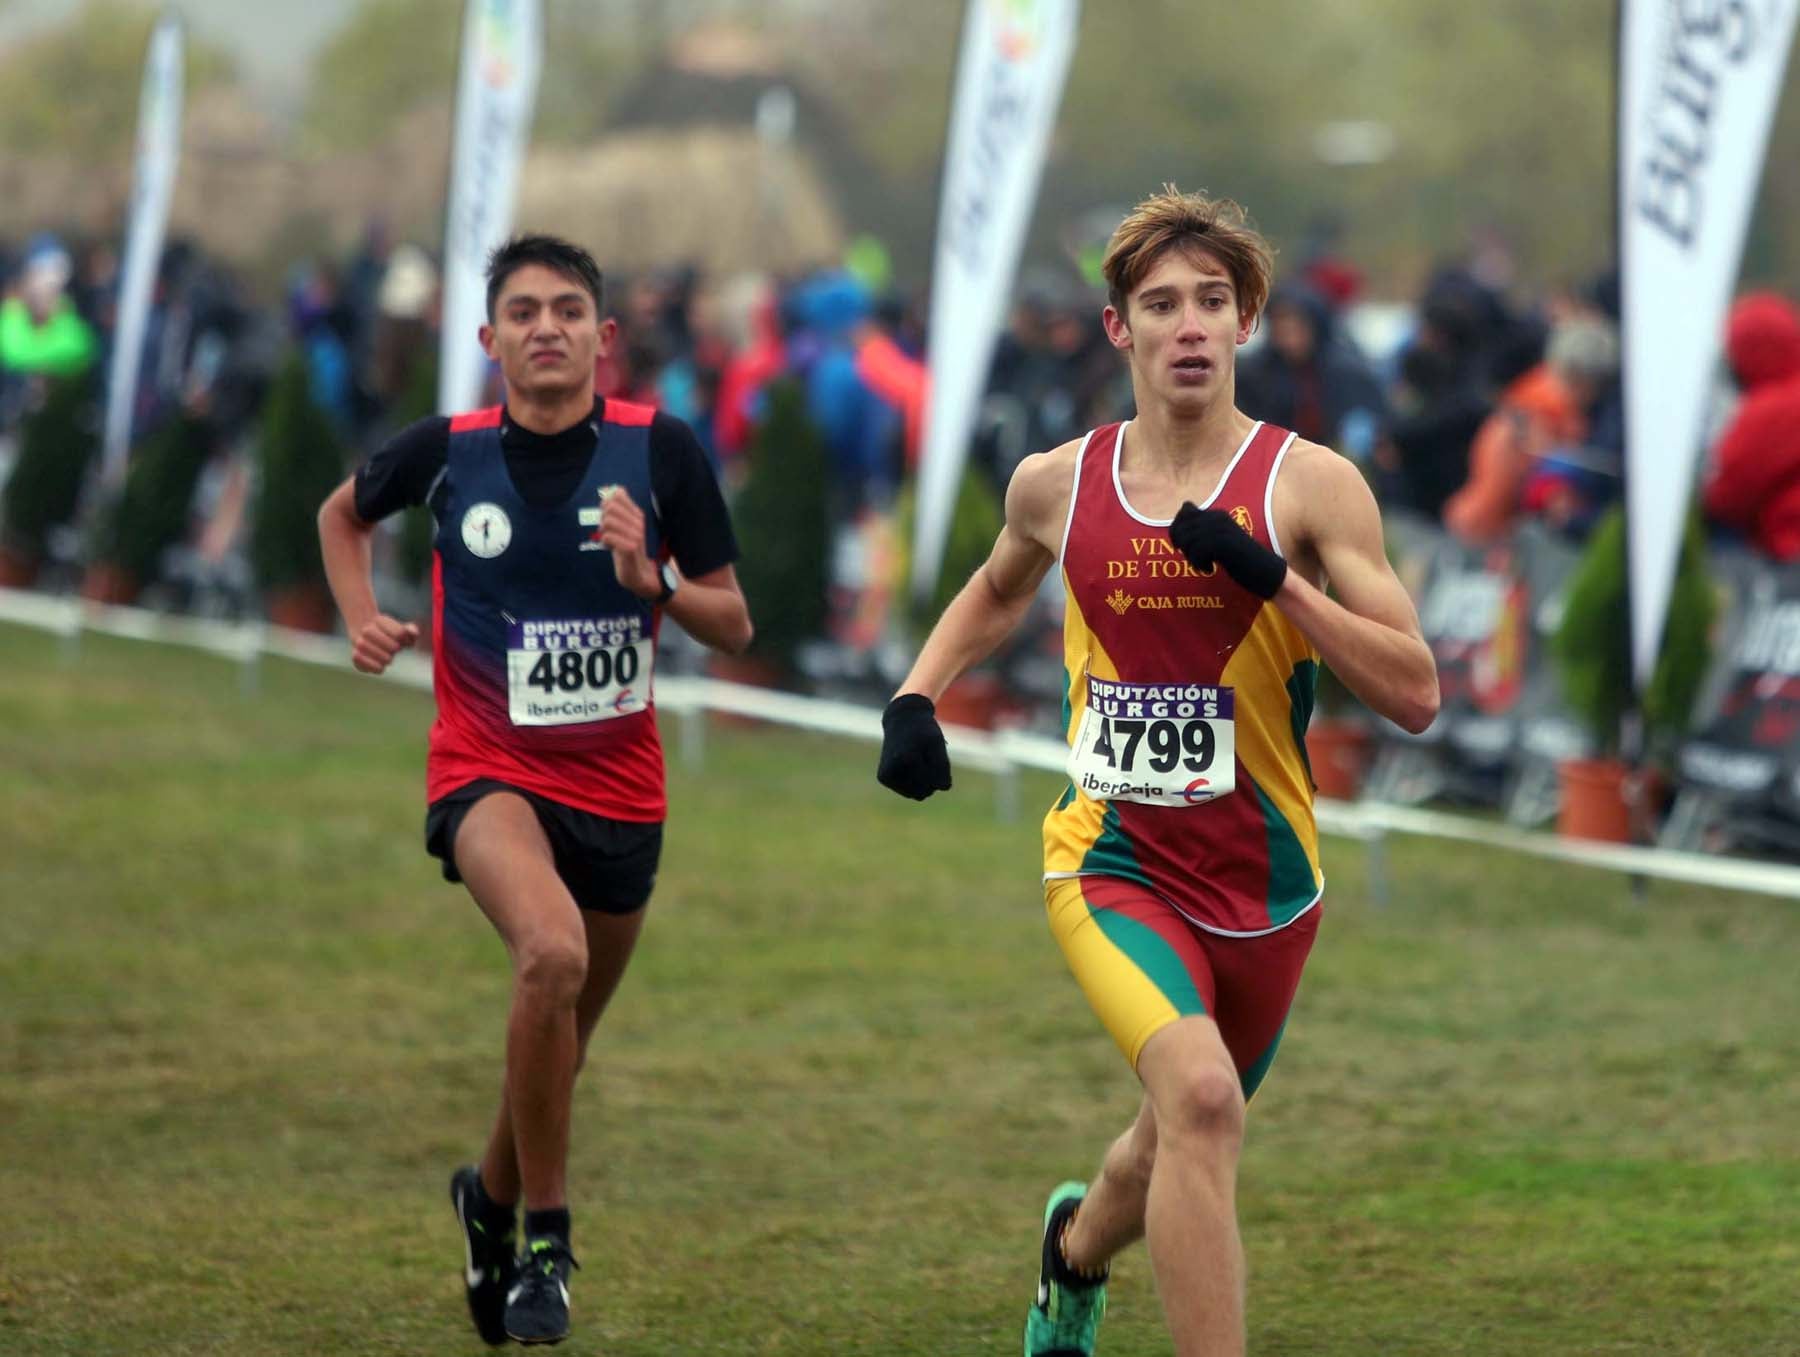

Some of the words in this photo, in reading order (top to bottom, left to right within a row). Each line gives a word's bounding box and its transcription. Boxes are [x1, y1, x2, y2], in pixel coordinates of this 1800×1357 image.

[1130, 538, 1184, 556] VIN
[1107, 560, 1139, 579] DE
[1137, 596, 1174, 610] CAJA
[1176, 596, 1225, 609] RURAL
[523, 616, 641, 637] DIPUTACIÓN
[523, 631, 640, 650] BURGOS
[528, 645, 639, 694] 4800
[1090, 679, 1218, 702] DIPUTACIÓN
[1092, 695, 1219, 718] BURGOS
[1092, 717, 1216, 774] 4799
[1082, 772, 1164, 798] iberCaja
